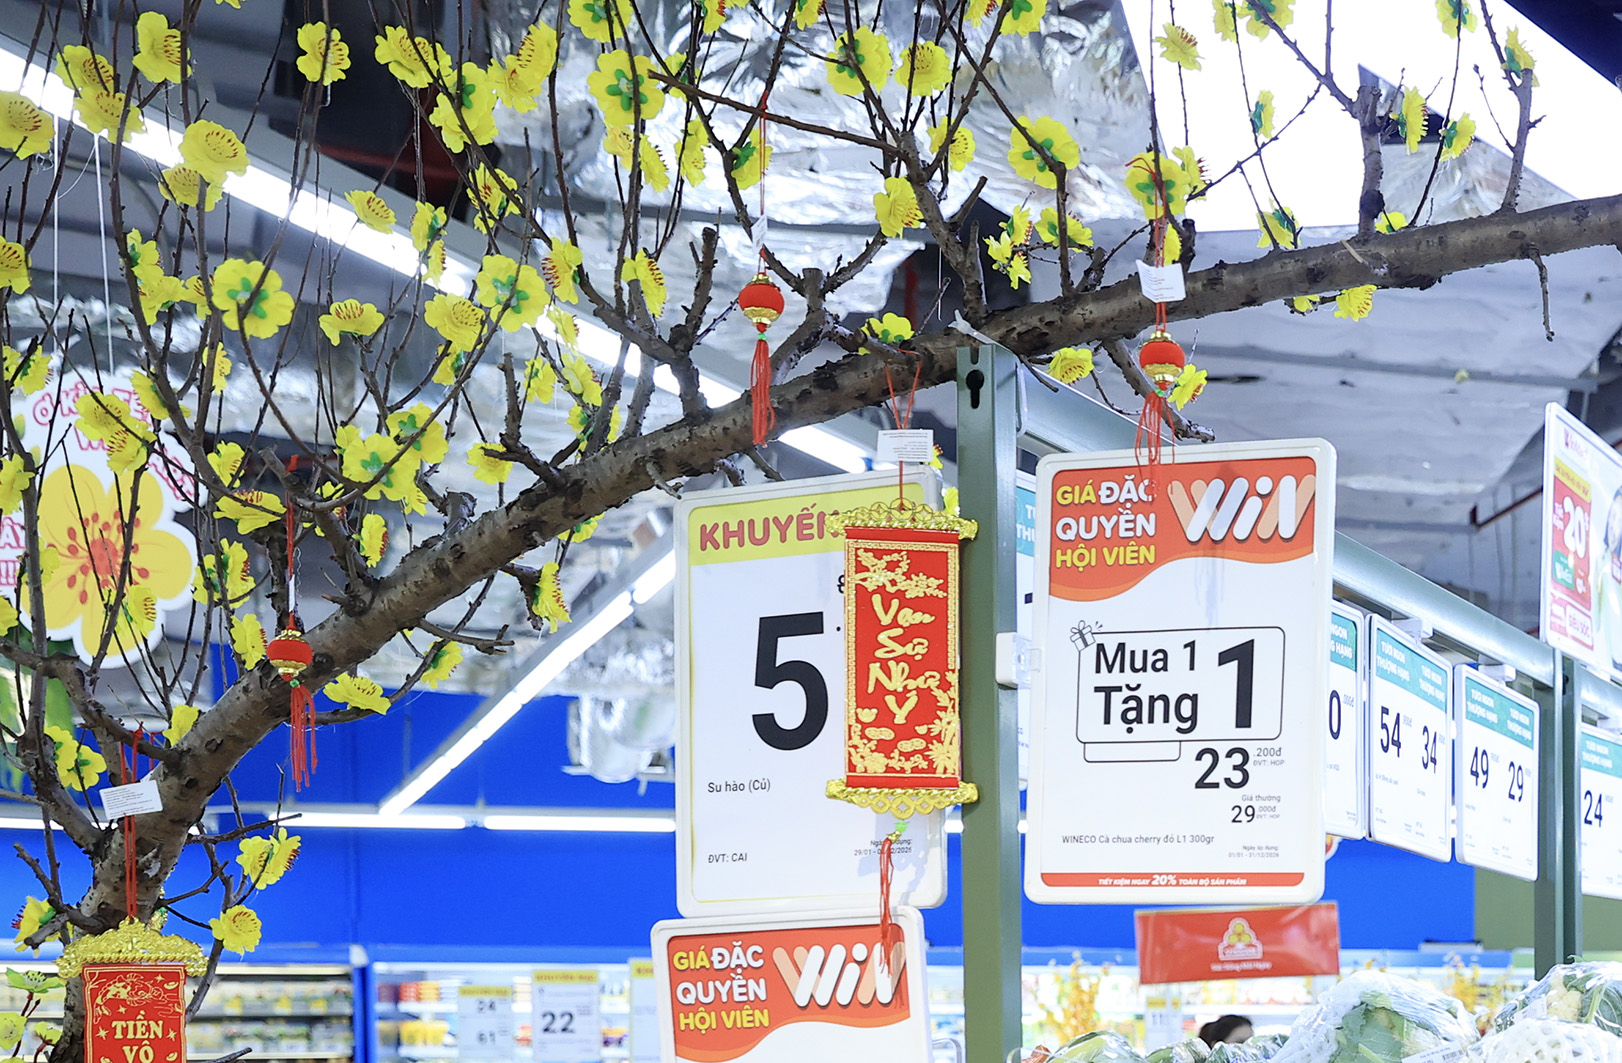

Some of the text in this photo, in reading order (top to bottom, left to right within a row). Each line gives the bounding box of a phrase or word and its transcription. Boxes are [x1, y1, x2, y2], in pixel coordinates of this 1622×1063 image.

[1056, 480, 1096, 505] GIÁ
[1056, 507, 1156, 540] QUYỀN
[1056, 541, 1155, 571] HỘI VIÊN
[875, 627, 929, 660] Sự
[1095, 640, 1195, 674] Mua 1
[752, 610, 829, 751] 5
[867, 660, 941, 693] Như
[1218, 639, 1254, 728] 1
[884, 690, 918, 724] Ý
[1094, 684, 1198, 734] Tặng
[1380, 705, 1401, 758] 54
[1422, 725, 1437, 774] 34
[1195, 747, 1249, 789] 23
[1470, 746, 1489, 788] 49
[1508, 761, 1524, 802] 29
[708, 778, 771, 793] Su hào (Củ)
[1232, 805, 1255, 823] 29
[1584, 790, 1603, 827] 24
[1062, 835, 1096, 843] WINECO
[1099, 834, 1109, 843] Cà
[1112, 835, 1132, 843] chua
[1134, 835, 1161, 845] cherry
[1177, 835, 1187, 843] L1
[1190, 835, 1214, 844] 300gr
[708, 853, 747, 863] ĐVT: CAI
[1151, 875, 1177, 885] 20%
[673, 940, 764, 974] GIÁ ĐẶC
[676, 972, 767, 1005] QUYỀN
[112, 1010, 163, 1039] TIỀN
[541, 1012, 575, 1033] 22
[680, 1005, 769, 1034] HỘI VIÊN
[122, 1040, 154, 1063] VÔ
